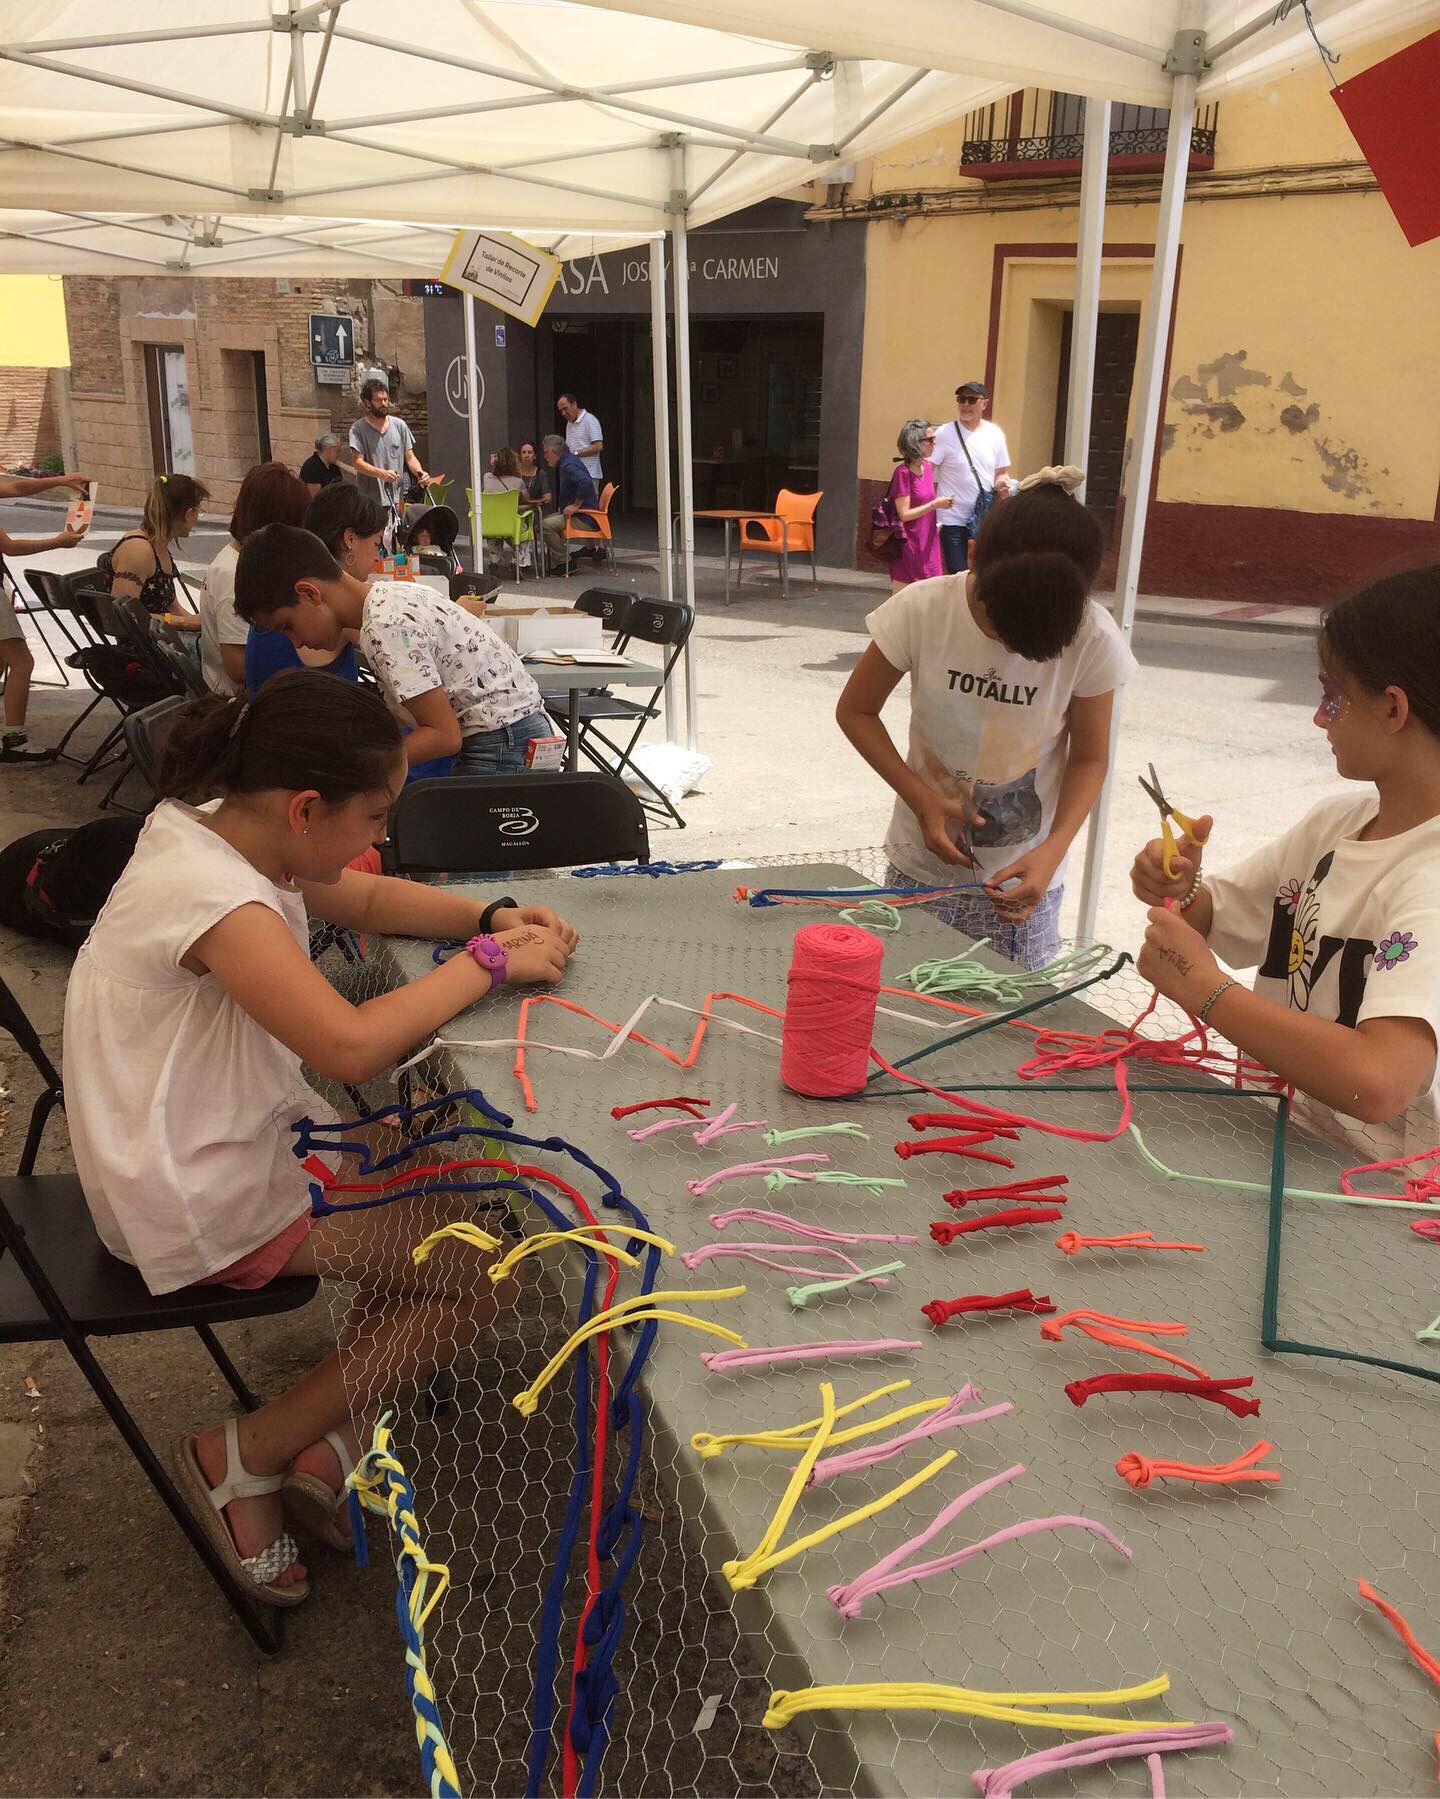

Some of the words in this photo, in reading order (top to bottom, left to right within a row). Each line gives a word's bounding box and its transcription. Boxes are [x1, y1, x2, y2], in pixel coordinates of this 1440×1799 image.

[481, 251, 497, 263] Taller
[497, 258, 505, 267] de
[505, 261, 527, 279] Recorte
[485, 264, 494, 273] de
[493, 267, 513, 284] Vinilos
[622, 261, 651, 286] JOS
[703, 257, 779, 280] CARMEN
[947, 669, 1038, 706] TOTALLY
